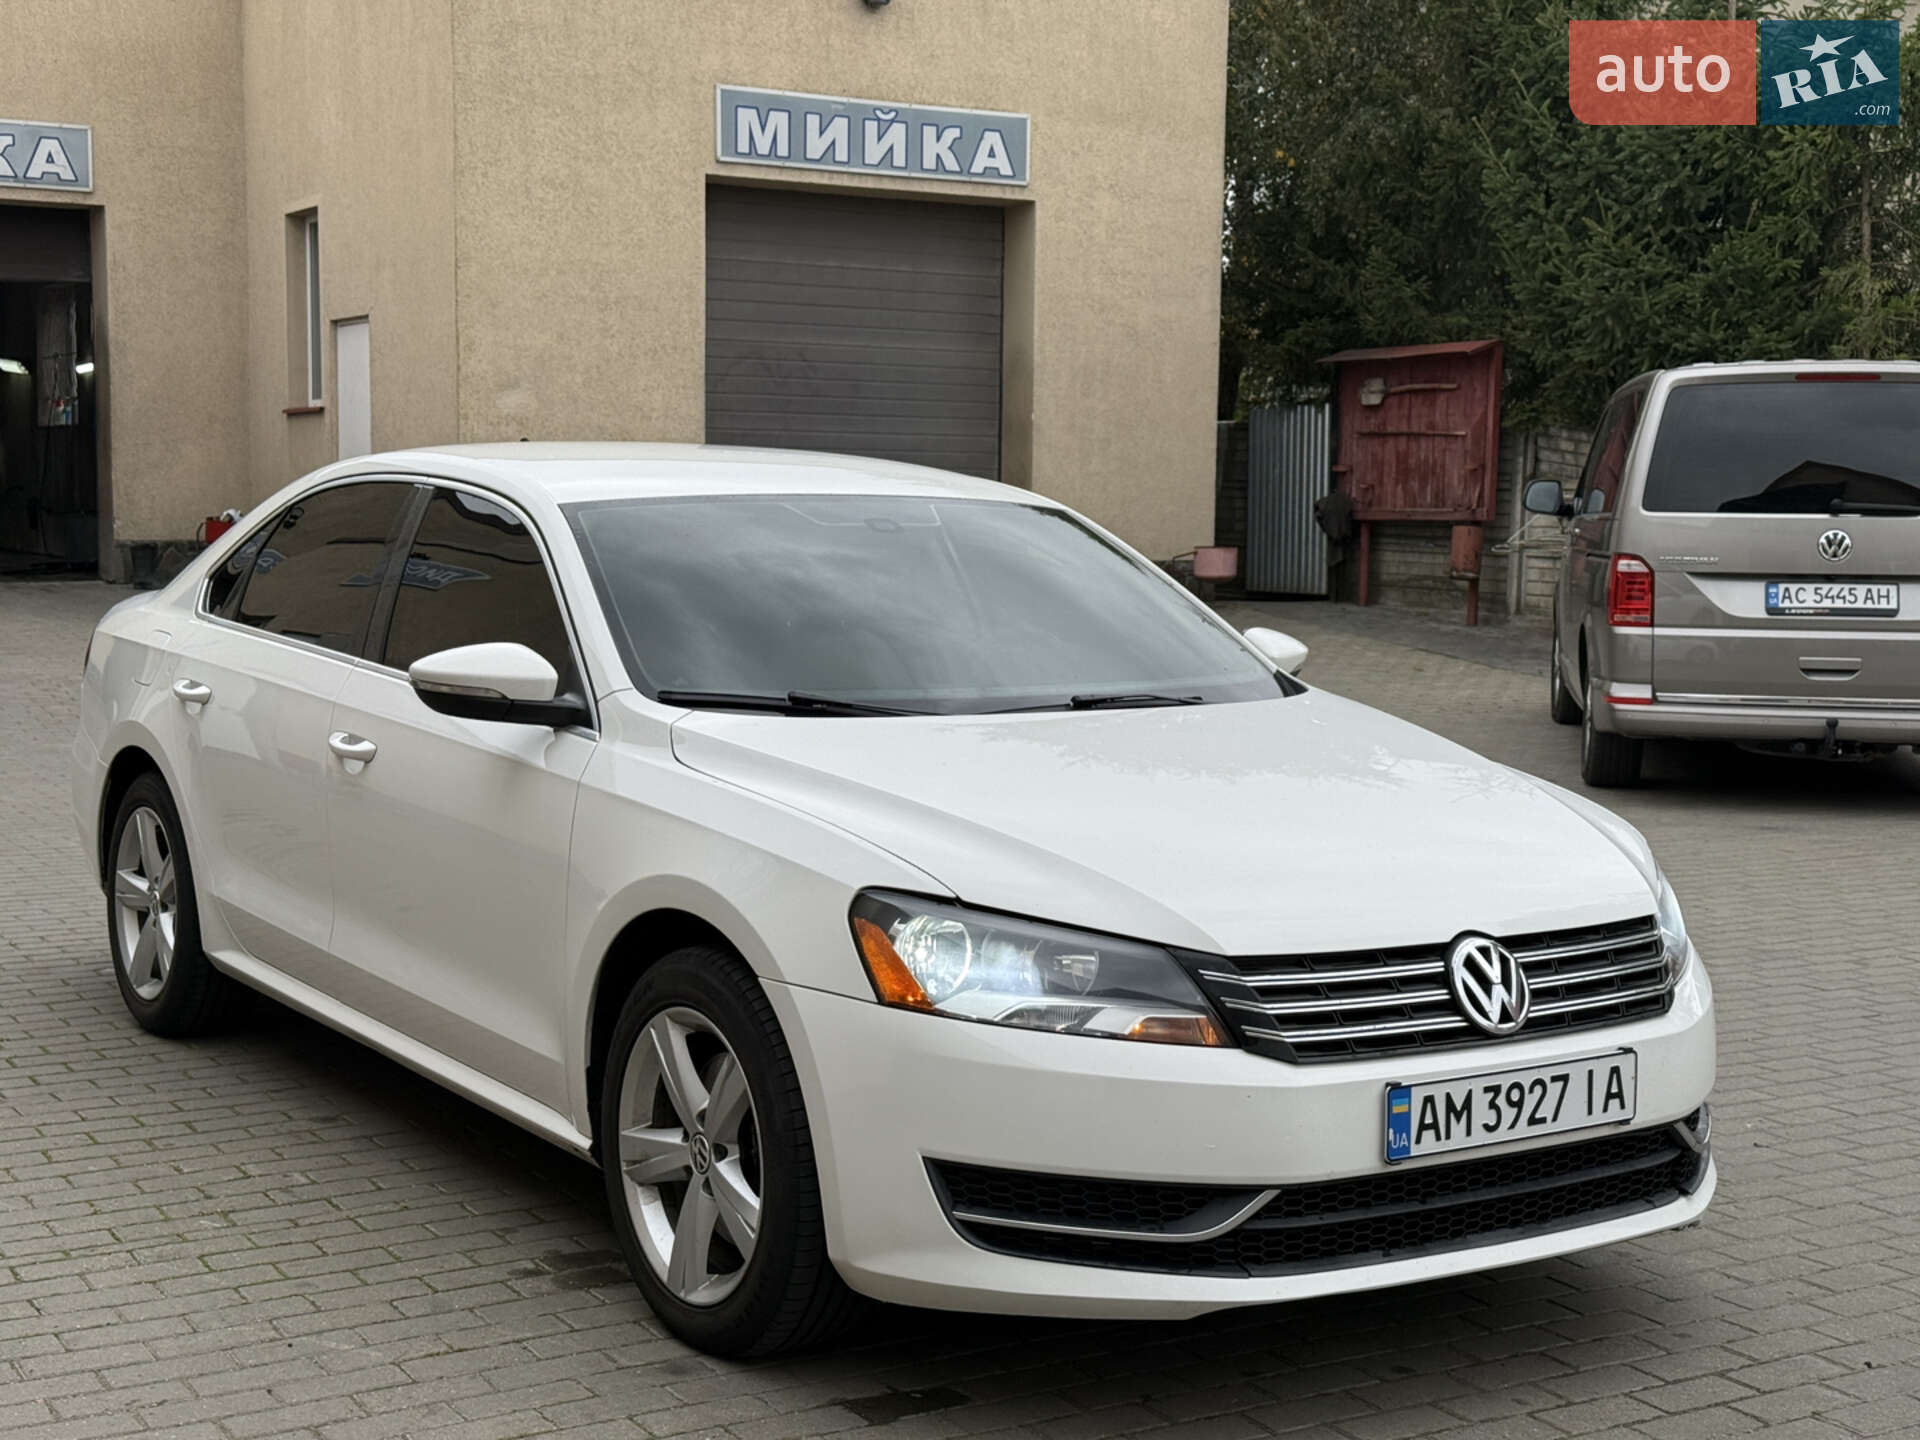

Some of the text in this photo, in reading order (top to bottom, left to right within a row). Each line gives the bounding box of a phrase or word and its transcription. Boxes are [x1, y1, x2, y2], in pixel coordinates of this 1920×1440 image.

[735, 105, 1016, 177] МИЙКА
[1781, 586, 1890, 605] AC 5445 AH
[1414, 1065, 1626, 1145] AM 3927 IA
[1391, 1132, 1409, 1148] UA
